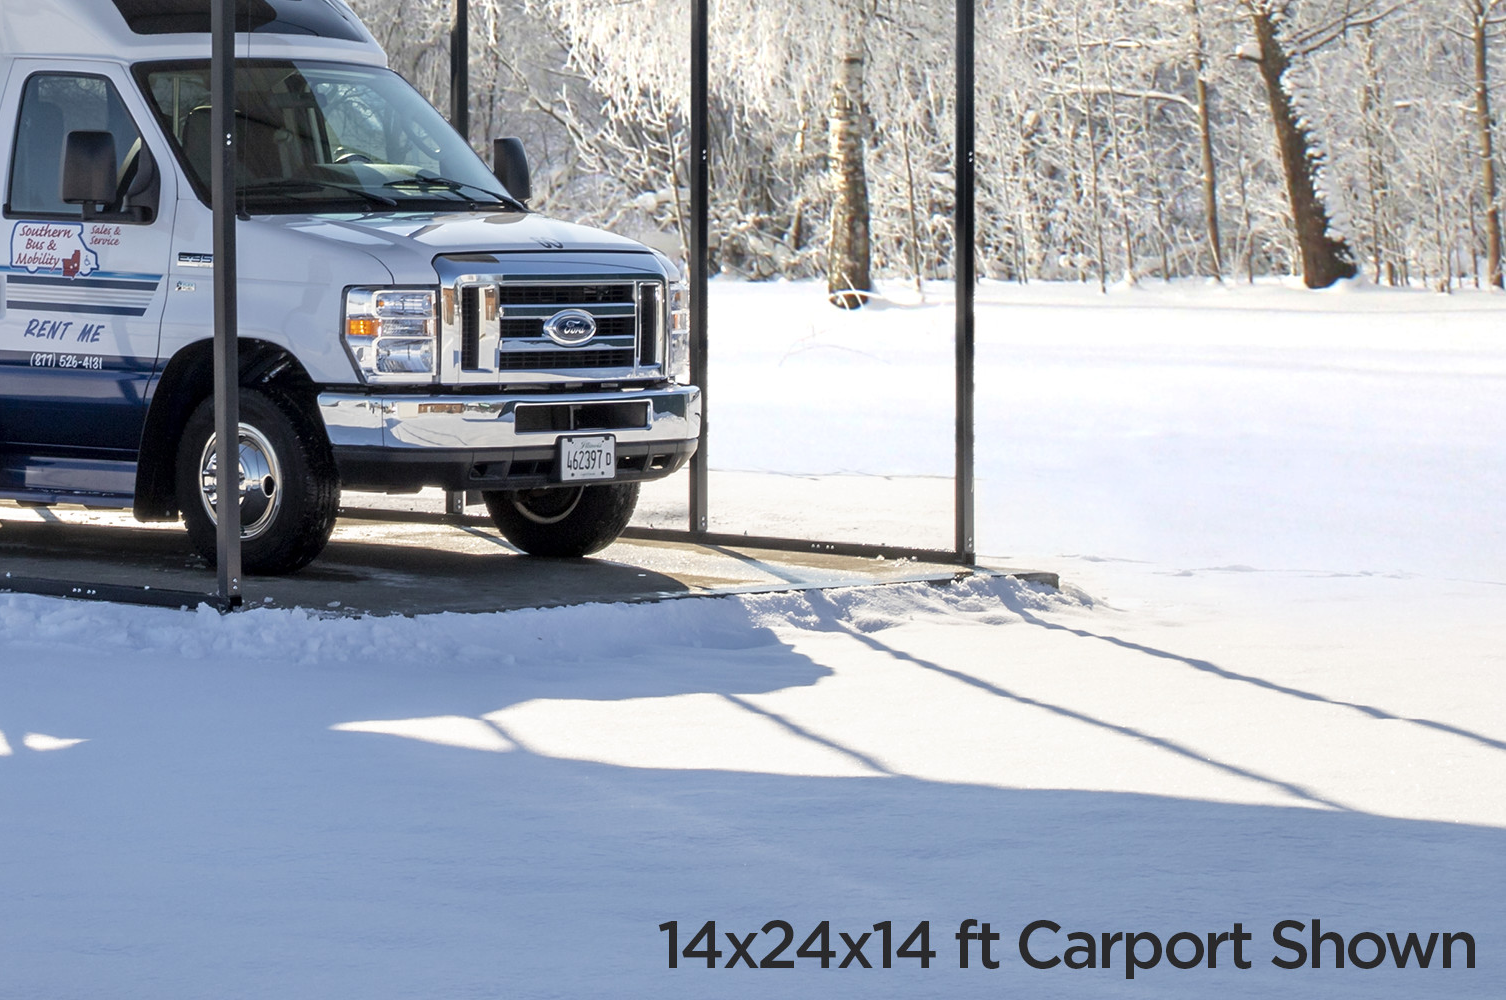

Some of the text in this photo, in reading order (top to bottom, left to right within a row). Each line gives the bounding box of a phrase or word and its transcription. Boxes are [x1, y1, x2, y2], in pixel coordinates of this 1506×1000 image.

[20, 224, 72, 238] Southern
[91, 224, 121, 235] Sales &
[26, 238, 57, 251] Bus &
[90, 236, 120, 246] Service
[15, 252, 60, 271] Mobility
[24, 319, 105, 343] RENT ME
[564, 320, 585, 334] Ford
[30, 352, 56, 368] (877)
[567, 450, 603, 470] 462397
